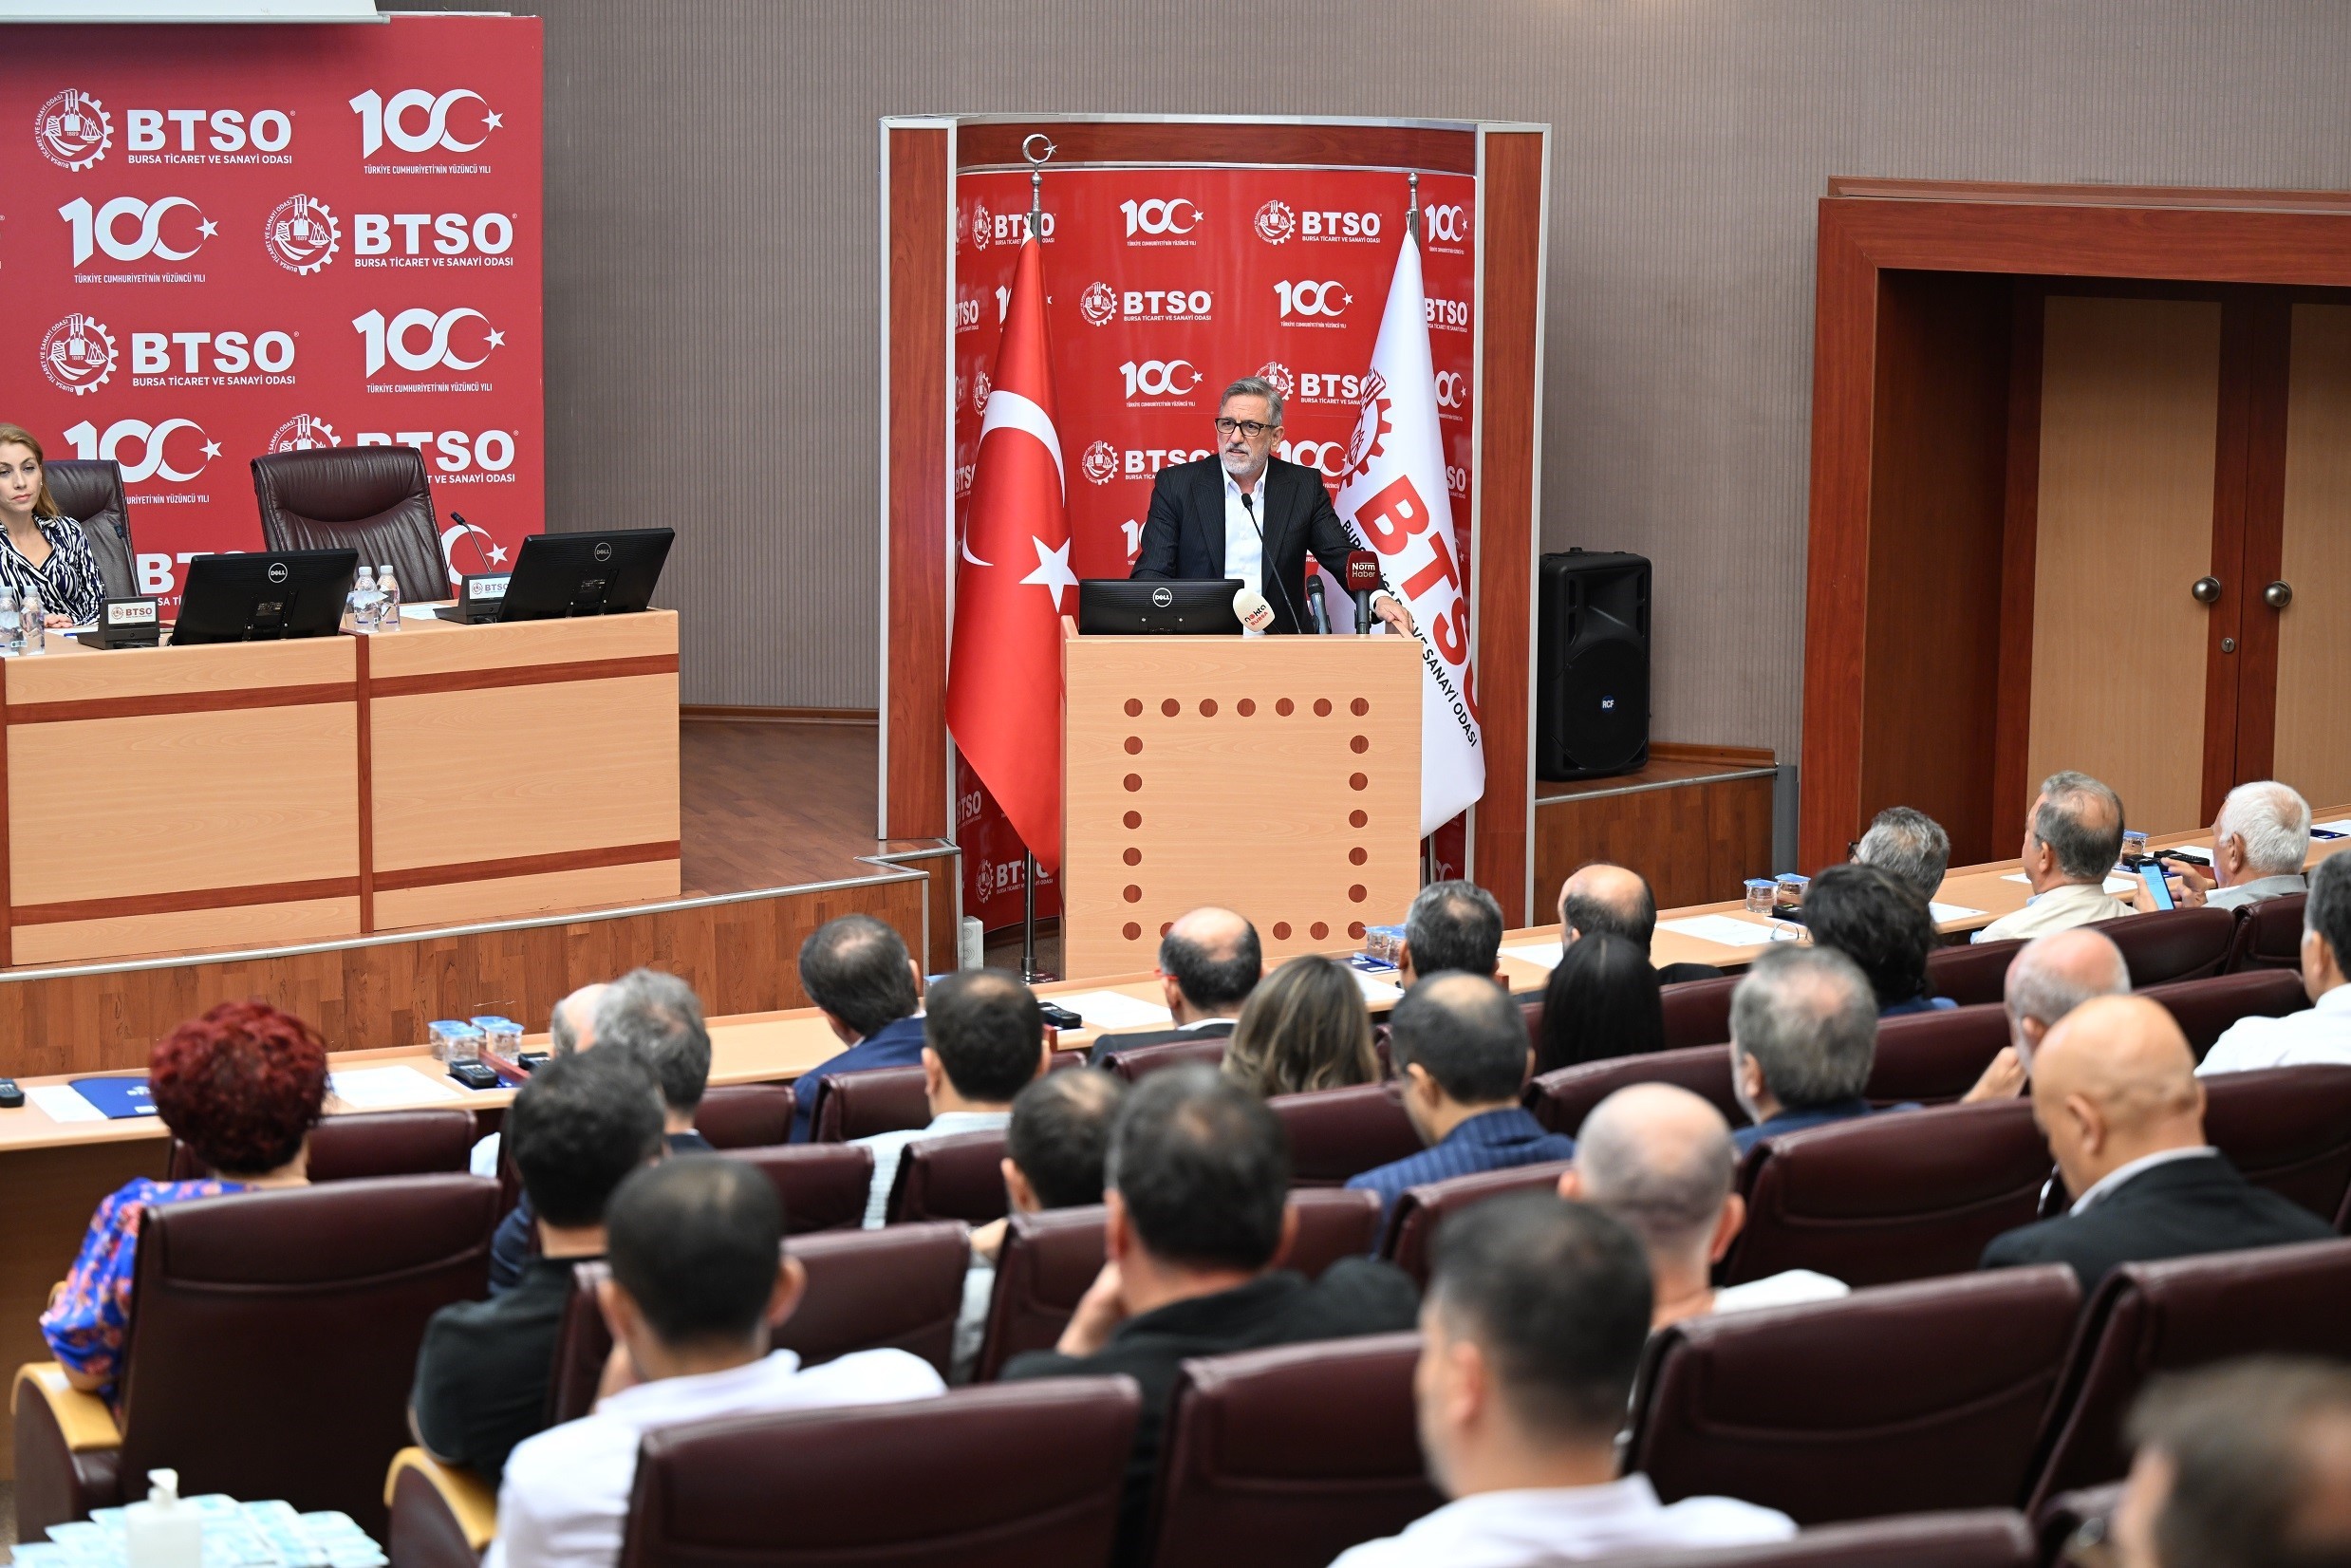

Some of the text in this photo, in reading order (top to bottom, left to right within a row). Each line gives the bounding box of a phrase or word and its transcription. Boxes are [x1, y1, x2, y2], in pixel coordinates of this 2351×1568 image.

[126, 109, 292, 152] BTSO
[348, 88, 488, 159] 100
[128, 153, 292, 164] BURSA TİCARET VE SANAYİ ODASI
[364, 163, 492, 175] TÜRKİYE CUMHURİYETİ'NİN YÜZÜNCÜ YILI
[1119, 198, 1196, 238] 100
[1302, 211, 1381, 236] BTSO
[1424, 203, 1465, 243] 100
[58, 196, 202, 269] 100
[354, 213, 513, 255] BTSO
[354, 255, 513, 268] BURSA TİCARET VE SANAYİ ODASI
[74, 272, 206, 284] TÜRKİYE CUMHURİYETİ'NİN YÜZÜNCÜ YILI
[1124, 290, 1212, 315] BTSO
[1273, 279, 1346, 319] 100
[1425, 297, 1467, 326] BTSO
[132, 331, 295, 374] BTSO
[351, 308, 491, 380] 100
[133, 374, 296, 386] BURSA TİCARET VE SANAYİ ODASI
[366, 382, 493, 393] TÜRKİYE CUMHURİYETİ'NİN YÜZÜNCÜ YILI
[1119, 360, 1195, 400] 100
[1434, 370, 1463, 409] 00
[435, 475, 447, 484] VE
[448, 473, 484, 484] SANAYİ
[485, 474, 515, 483] ODASI
[955, 463, 976, 494] BTS
[1446, 465, 1466, 492] SO
[124, 493, 210, 504] URİYETİ'NİN YÜZÜNCÜ YILI
[1352, 562, 1375, 570] Norm
[125, 607, 153, 616] BTSO
[1250, 611, 1268, 625] BURSA
[1423, 648, 1459, 702] SANAYİ
[1453, 702, 1478, 747] ODASI
[1602, 700, 1614, 709] RCF
